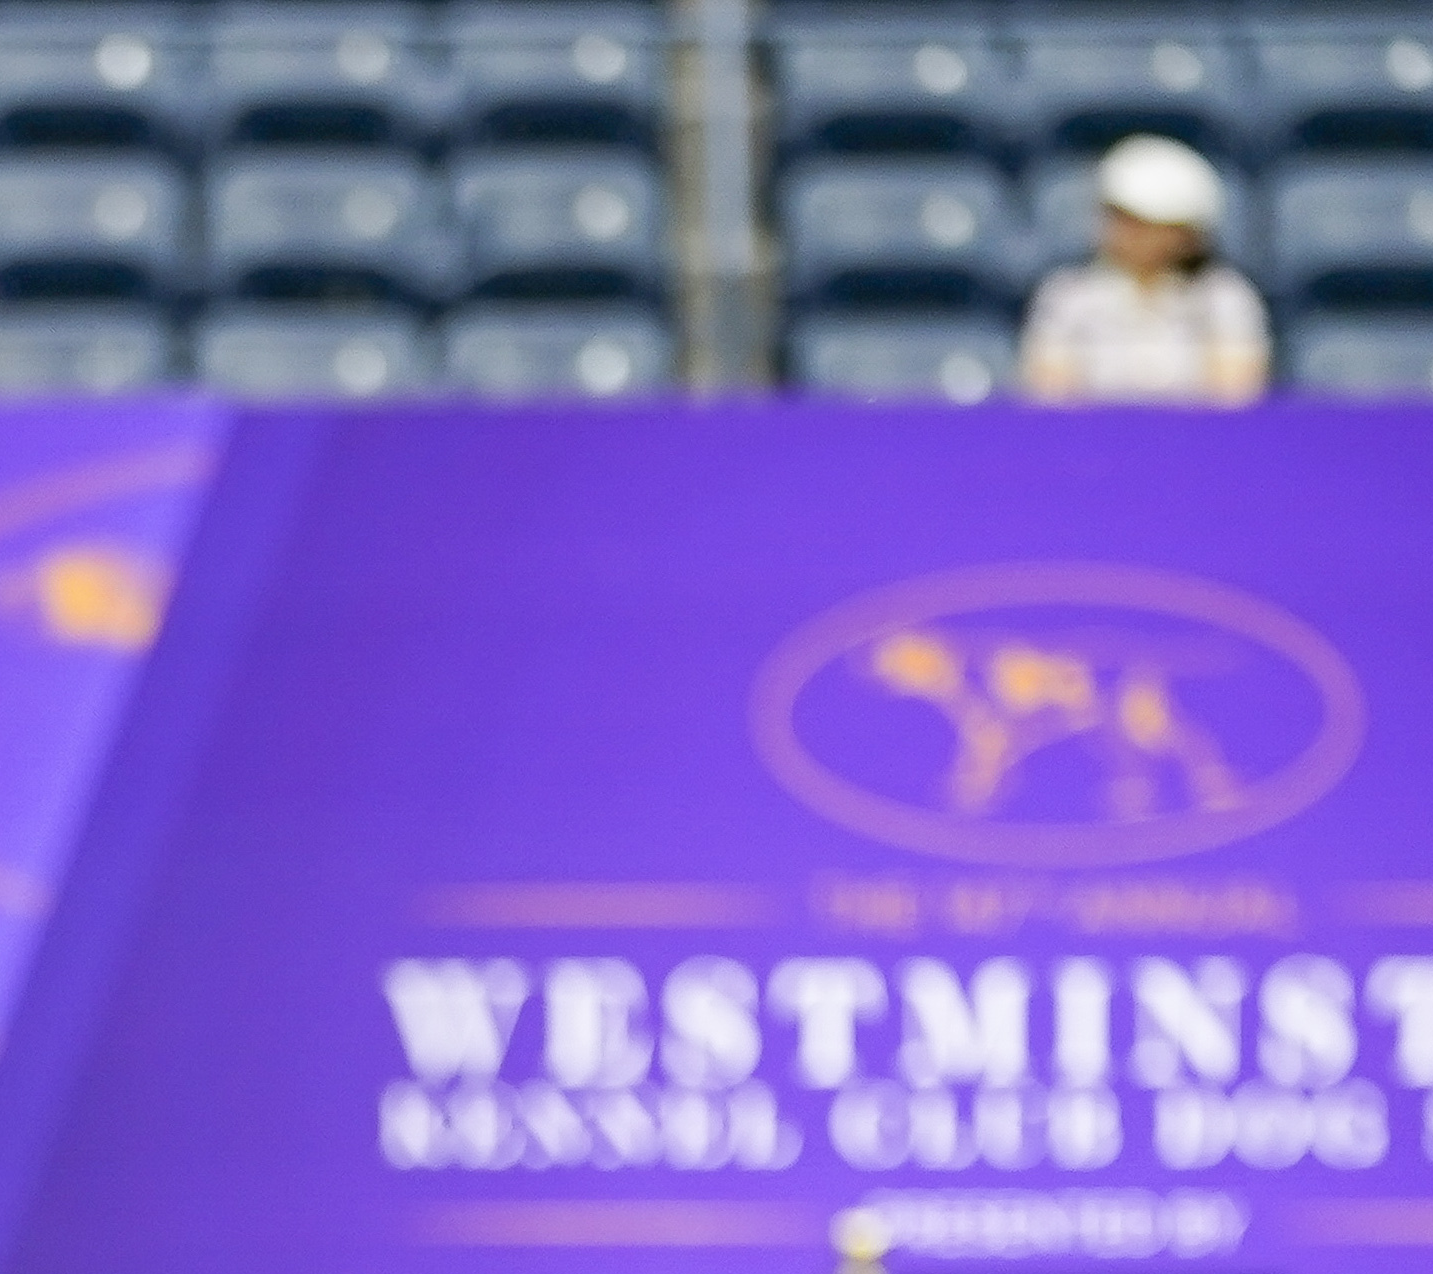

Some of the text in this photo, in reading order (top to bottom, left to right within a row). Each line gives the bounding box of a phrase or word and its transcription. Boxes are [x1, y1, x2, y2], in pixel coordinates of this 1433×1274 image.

[378, 1077, 804, 1171] KENNEL
[828, 1077, 1124, 1171] CLUB
[1152, 1077, 1392, 1171] DOG
